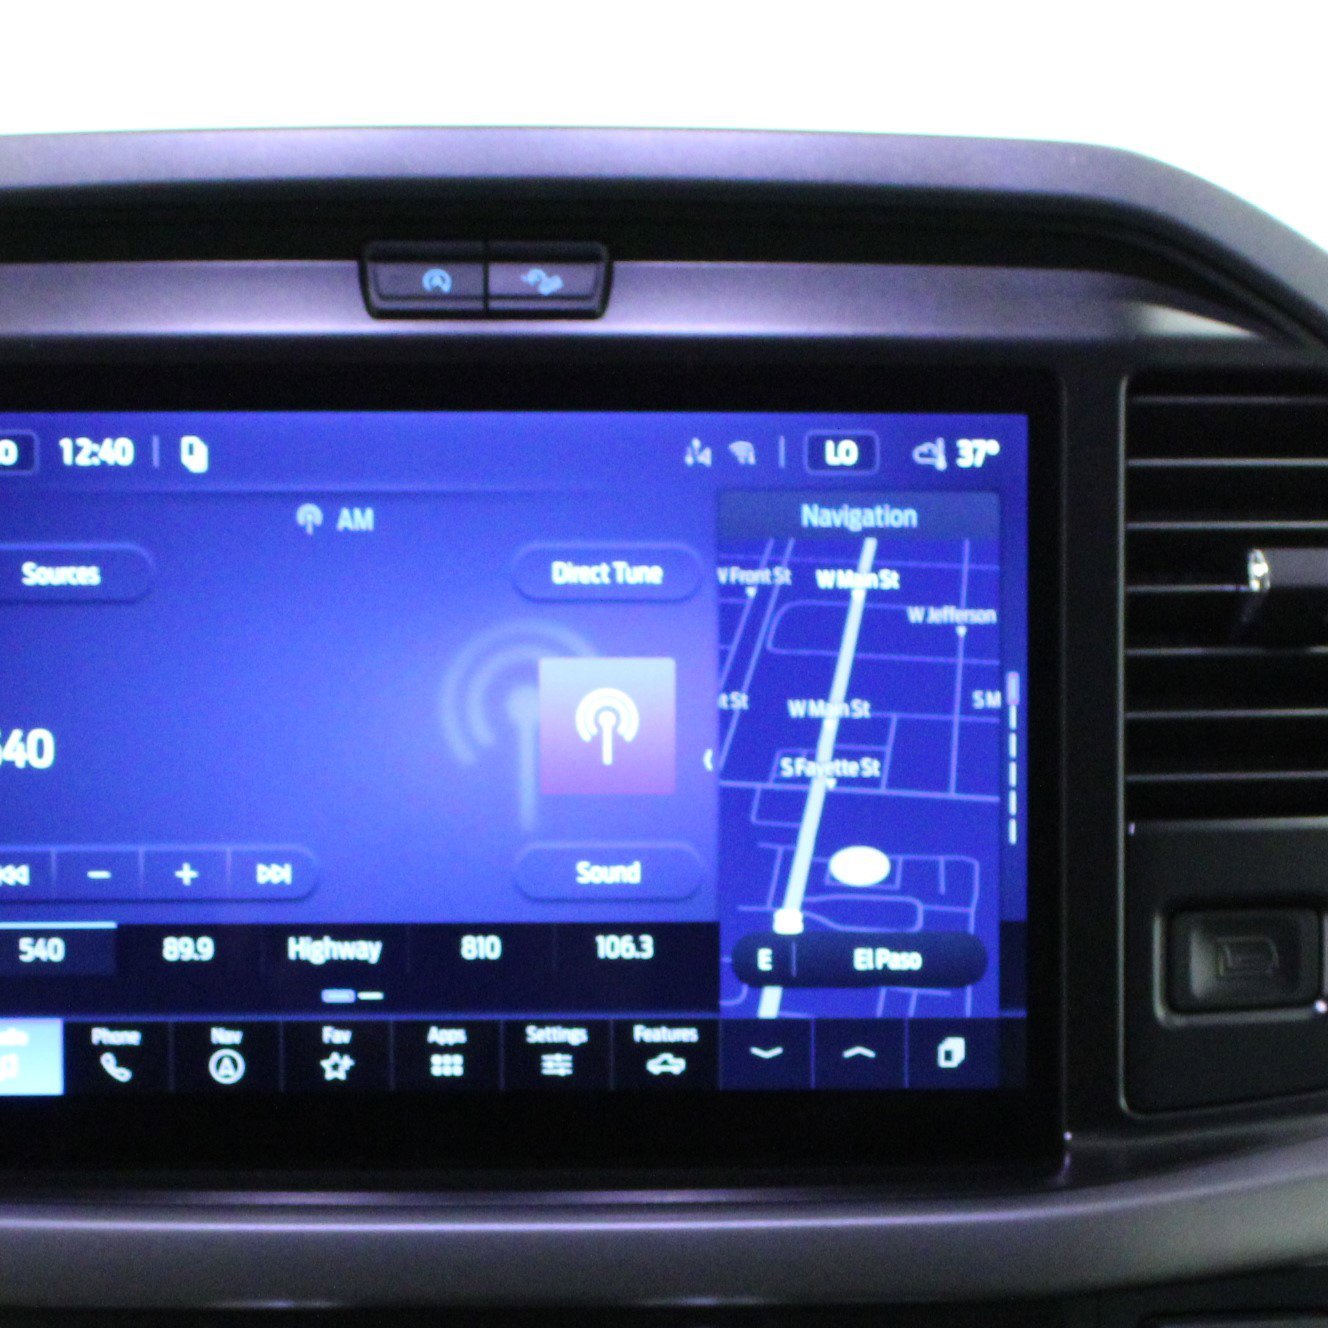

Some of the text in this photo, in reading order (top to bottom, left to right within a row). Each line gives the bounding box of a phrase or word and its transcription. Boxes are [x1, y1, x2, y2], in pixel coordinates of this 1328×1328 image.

[59, 437, 135, 467] 12:40
[824, 440, 859, 466] LO
[956, 438, 1000, 468] 37°
[337, 508, 375, 531] AM
[801, 504, 918, 532] Navigation
[21, 561, 101, 586] Sources
[551, 561, 663, 585] Direct Tune
[773, 566, 792, 585] St
[816, 569, 836, 589] W
[879, 569, 900, 589] St
[907, 605, 997, 624] W Jefferson
[788, 699, 808, 718] W
[850, 699, 871, 718] St
[972, 690, 984, 709] S
[780, 757, 793, 777] S
[860, 757, 881, 777] St
[576, 861, 641, 885] Sound
[18, 937, 65, 962] 540
[162, 936, 215, 961] 89.9
[287, 936, 383, 965] Highway
[460, 935, 502, 960] 810
[595, 935, 654, 960] 106.3
[757, 949, 772, 971] E
[853, 948, 922, 971] El Paso
[91, 1027, 141, 1045] Phone
[210, 1027, 242, 1044] Nav
[322, 1026, 352, 1044] Fav
[427, 1026, 467, 1045] Apps
[525, 1026, 588, 1045] Settings
[633, 1025, 699, 1044] Features
